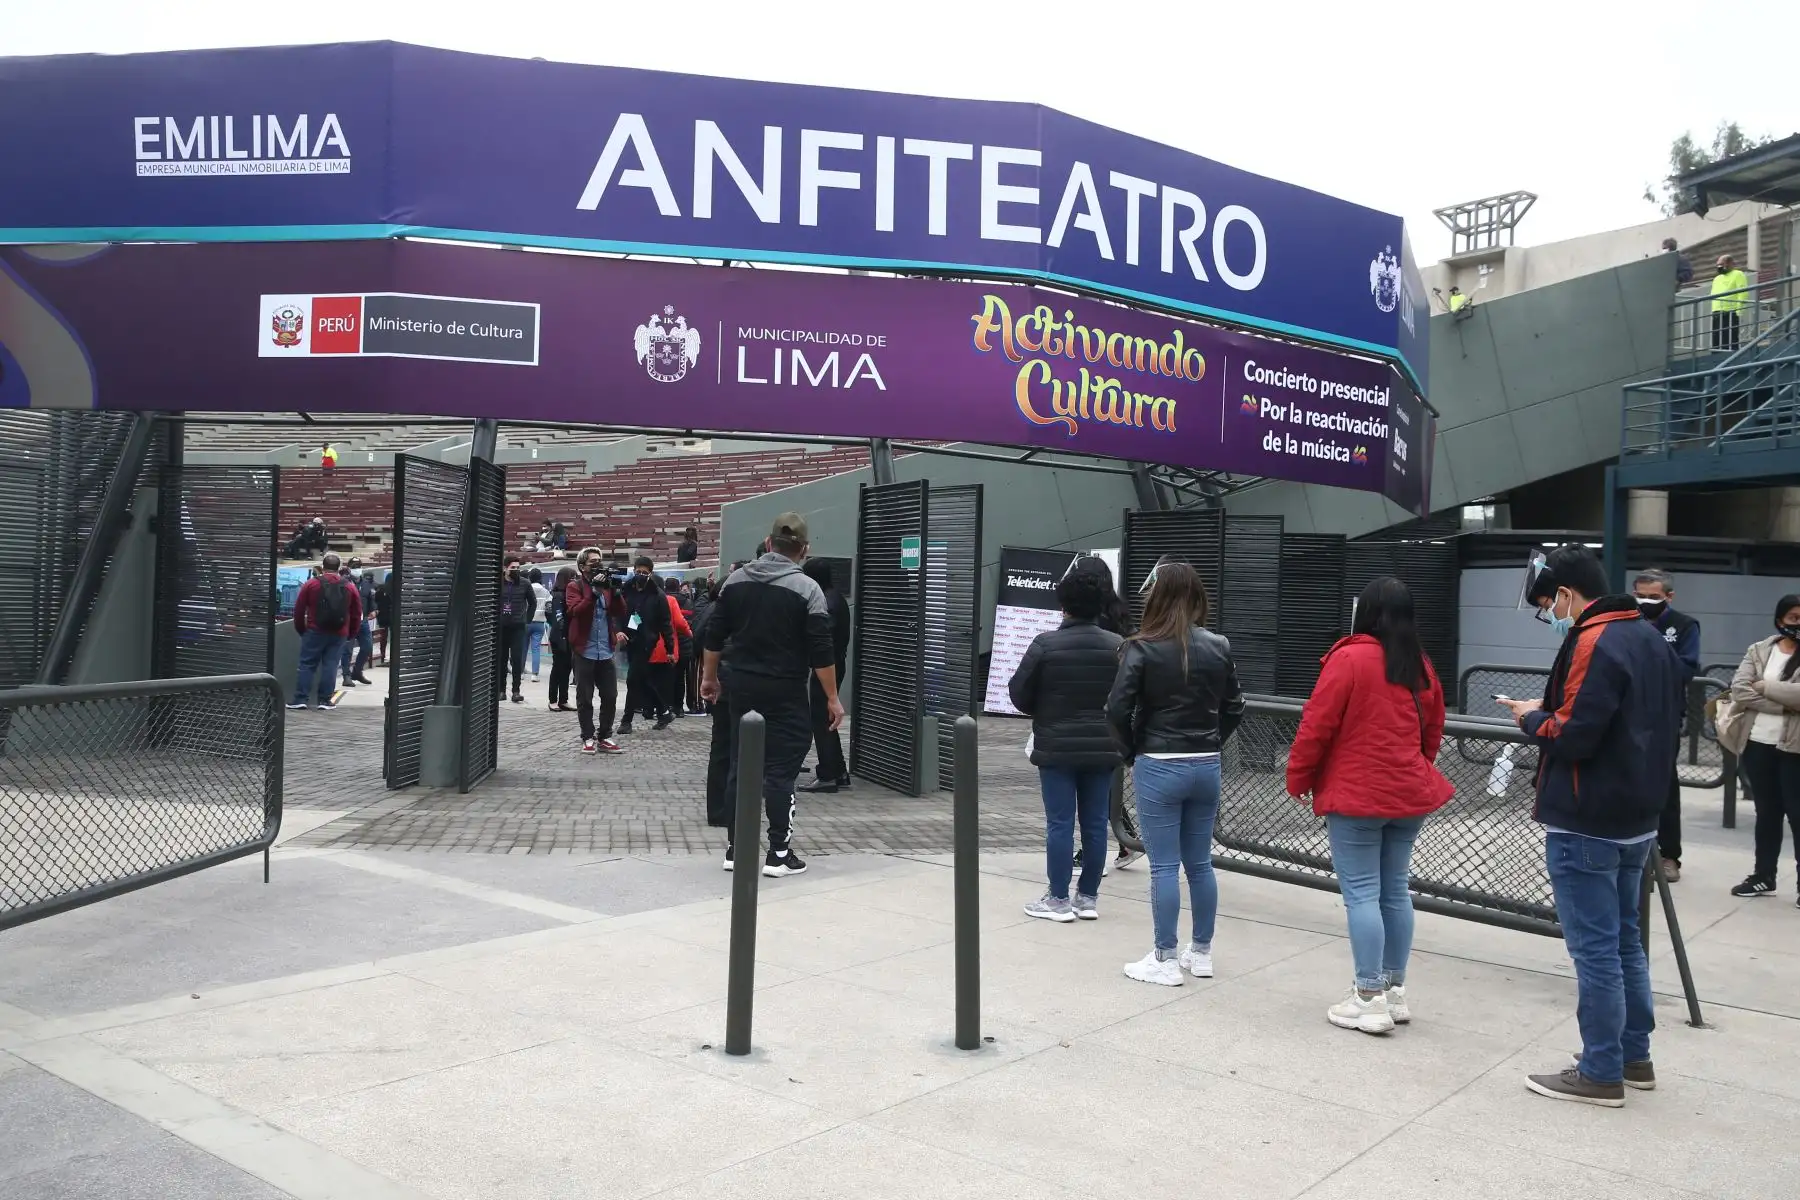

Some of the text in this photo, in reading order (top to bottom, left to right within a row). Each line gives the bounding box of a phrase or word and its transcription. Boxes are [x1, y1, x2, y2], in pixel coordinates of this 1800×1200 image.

[134, 113, 351, 160] EMILIMA
[138, 161, 349, 175] EMPRESA MUNICIPAL INMOBILIARIA DE LIMA
[575, 112, 1267, 291] ANFITEATRO
[318, 313, 355, 332] PERÚ
[369, 317, 523, 339] Ministerio de Cultura
[738, 326, 887, 347] MUNICIPALIDAD DE
[970, 294, 1206, 382] Activando
[737, 345, 887, 391] LIMA
[1243, 359, 1390, 407] Concierto presencial
[1015, 358, 1177, 436] Cultura
[1260, 397, 1287, 422] Por
[1289, 402, 1302, 424] la
[1305, 410, 1389, 439] reactivación
[1262, 430, 1350, 463] de la música
